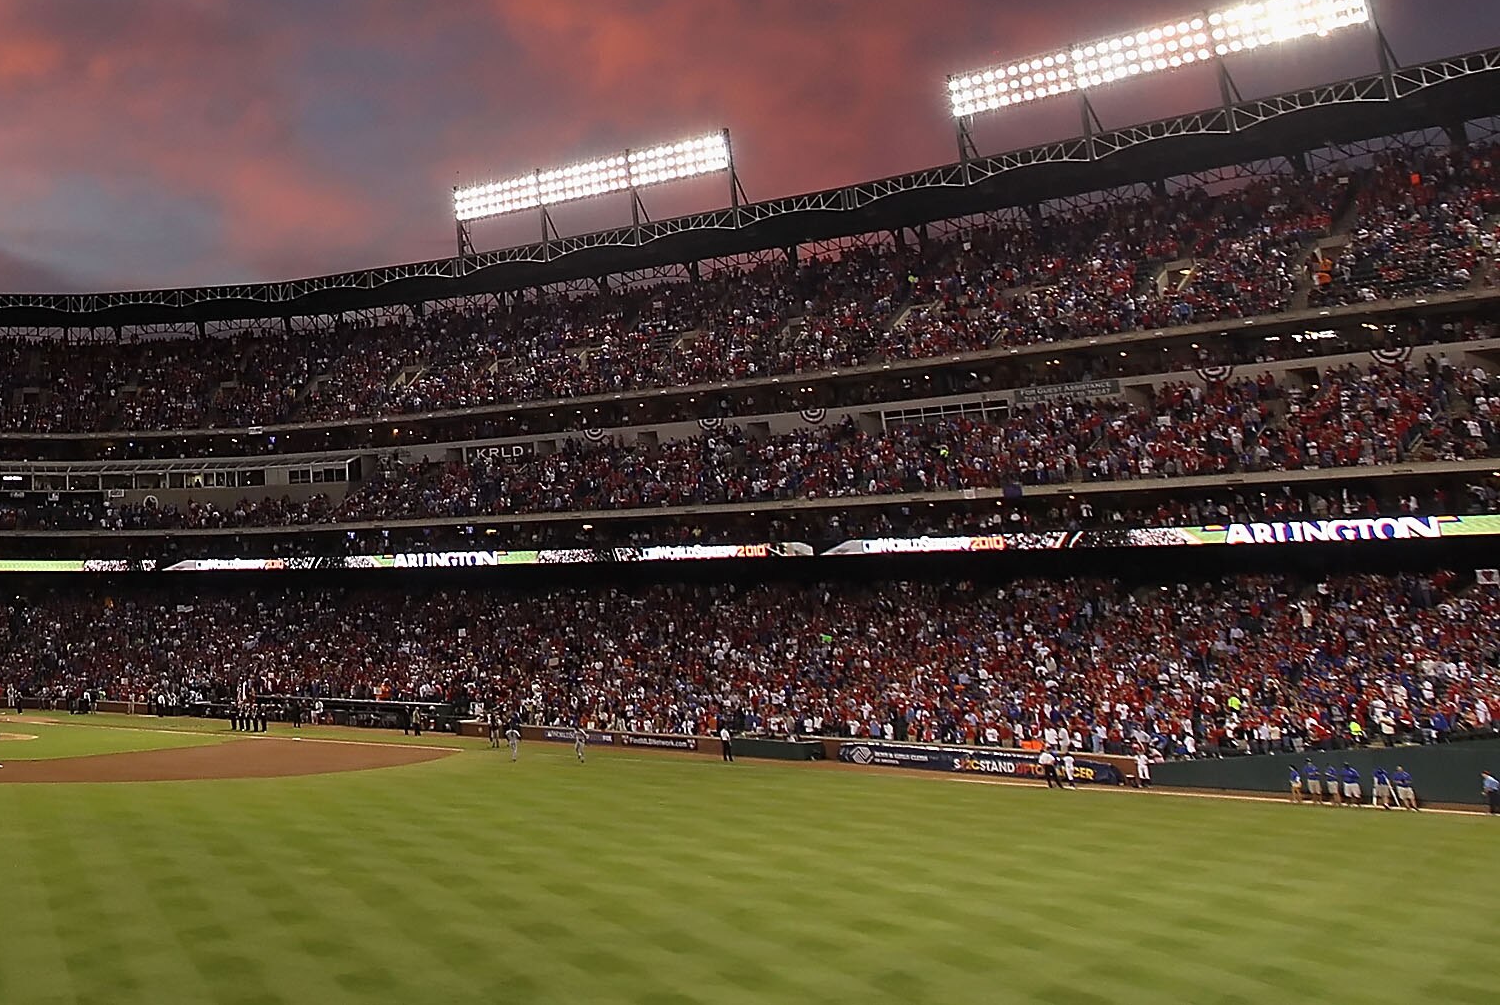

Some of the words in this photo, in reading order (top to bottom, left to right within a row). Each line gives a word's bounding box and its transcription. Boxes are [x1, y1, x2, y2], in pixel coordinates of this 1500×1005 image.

[476, 446, 524, 460] KRLD
[1226, 516, 1442, 545] ARLINGTON
[970, 536, 1004, 550] 2010
[737, 544, 767, 557] 2010
[393, 550, 498, 568] ARLINGTON
[980, 760, 1016, 773] STAND
